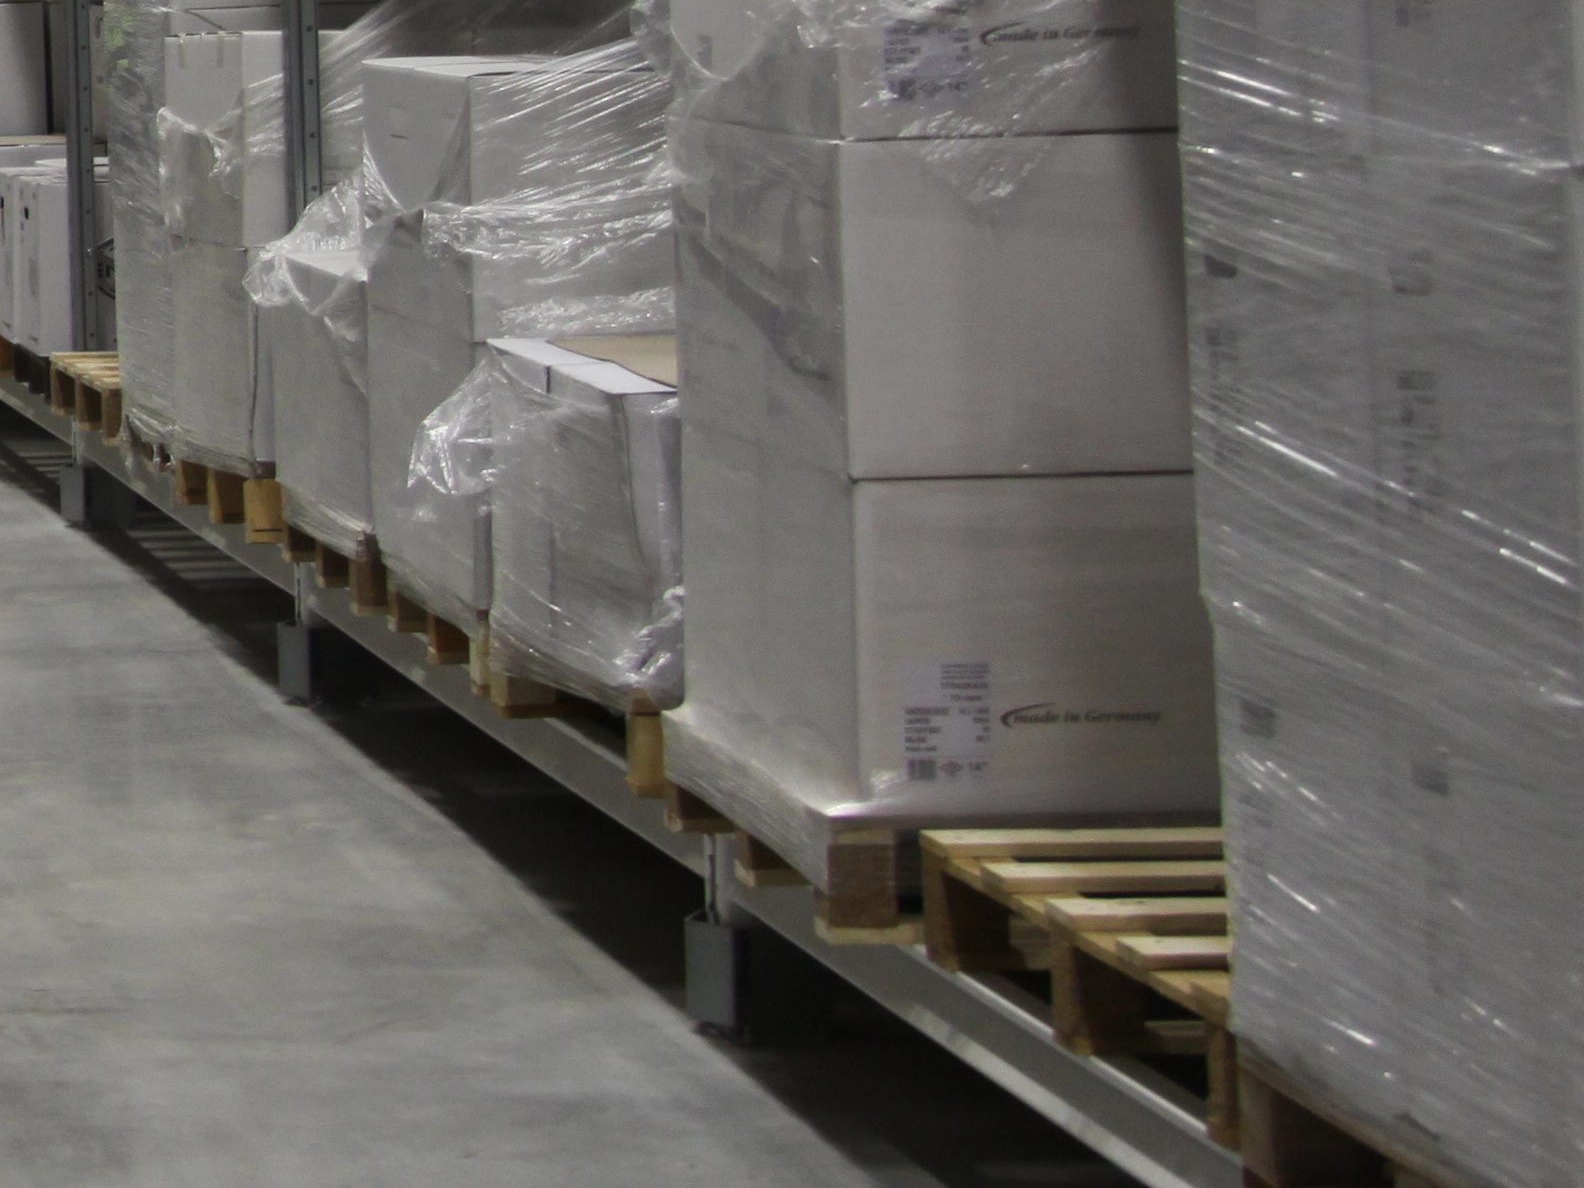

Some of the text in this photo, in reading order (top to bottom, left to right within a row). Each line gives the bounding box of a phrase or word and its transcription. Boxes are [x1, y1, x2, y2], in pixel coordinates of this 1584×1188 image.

[1013, 709, 1161, 725] made in Germany
